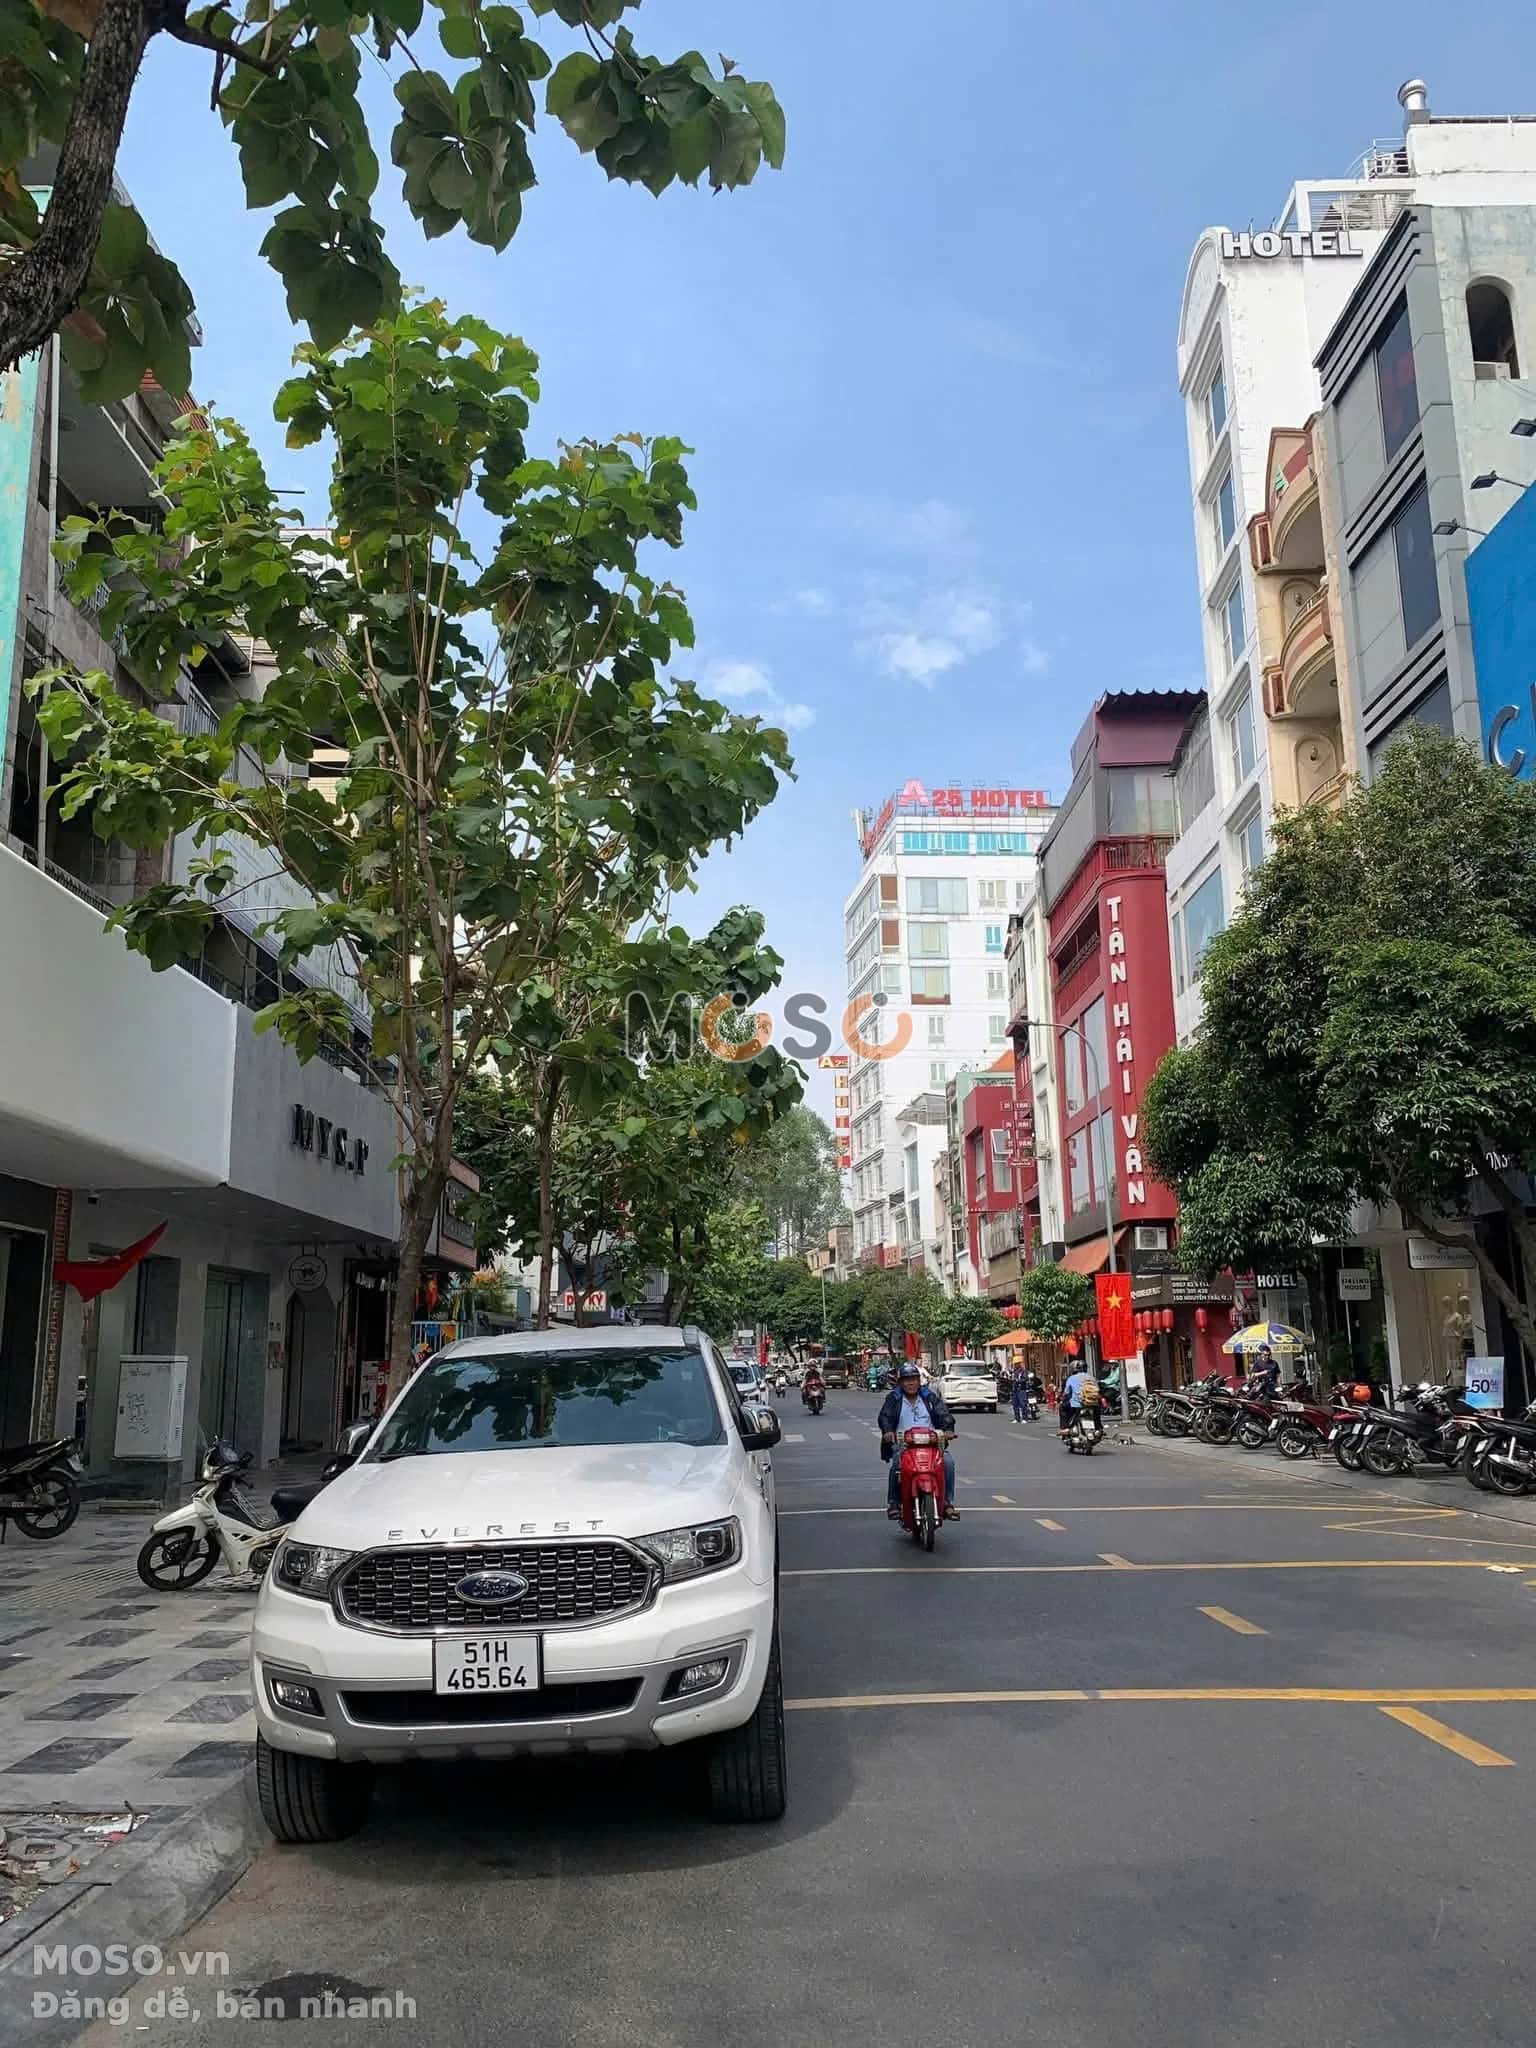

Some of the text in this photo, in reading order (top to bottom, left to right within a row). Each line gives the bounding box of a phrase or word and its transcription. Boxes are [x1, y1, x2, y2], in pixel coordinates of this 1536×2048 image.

[1222, 230, 1363, 259] HOTEL
[970, 789, 1049, 808] HOTEL
[1257, 1274, 1297, 1288] HOTEL
[387, 1519, 605, 1541] EVEREST
[463, 1641, 509, 1665] 51H
[446, 1667, 528, 1691] 465.64
